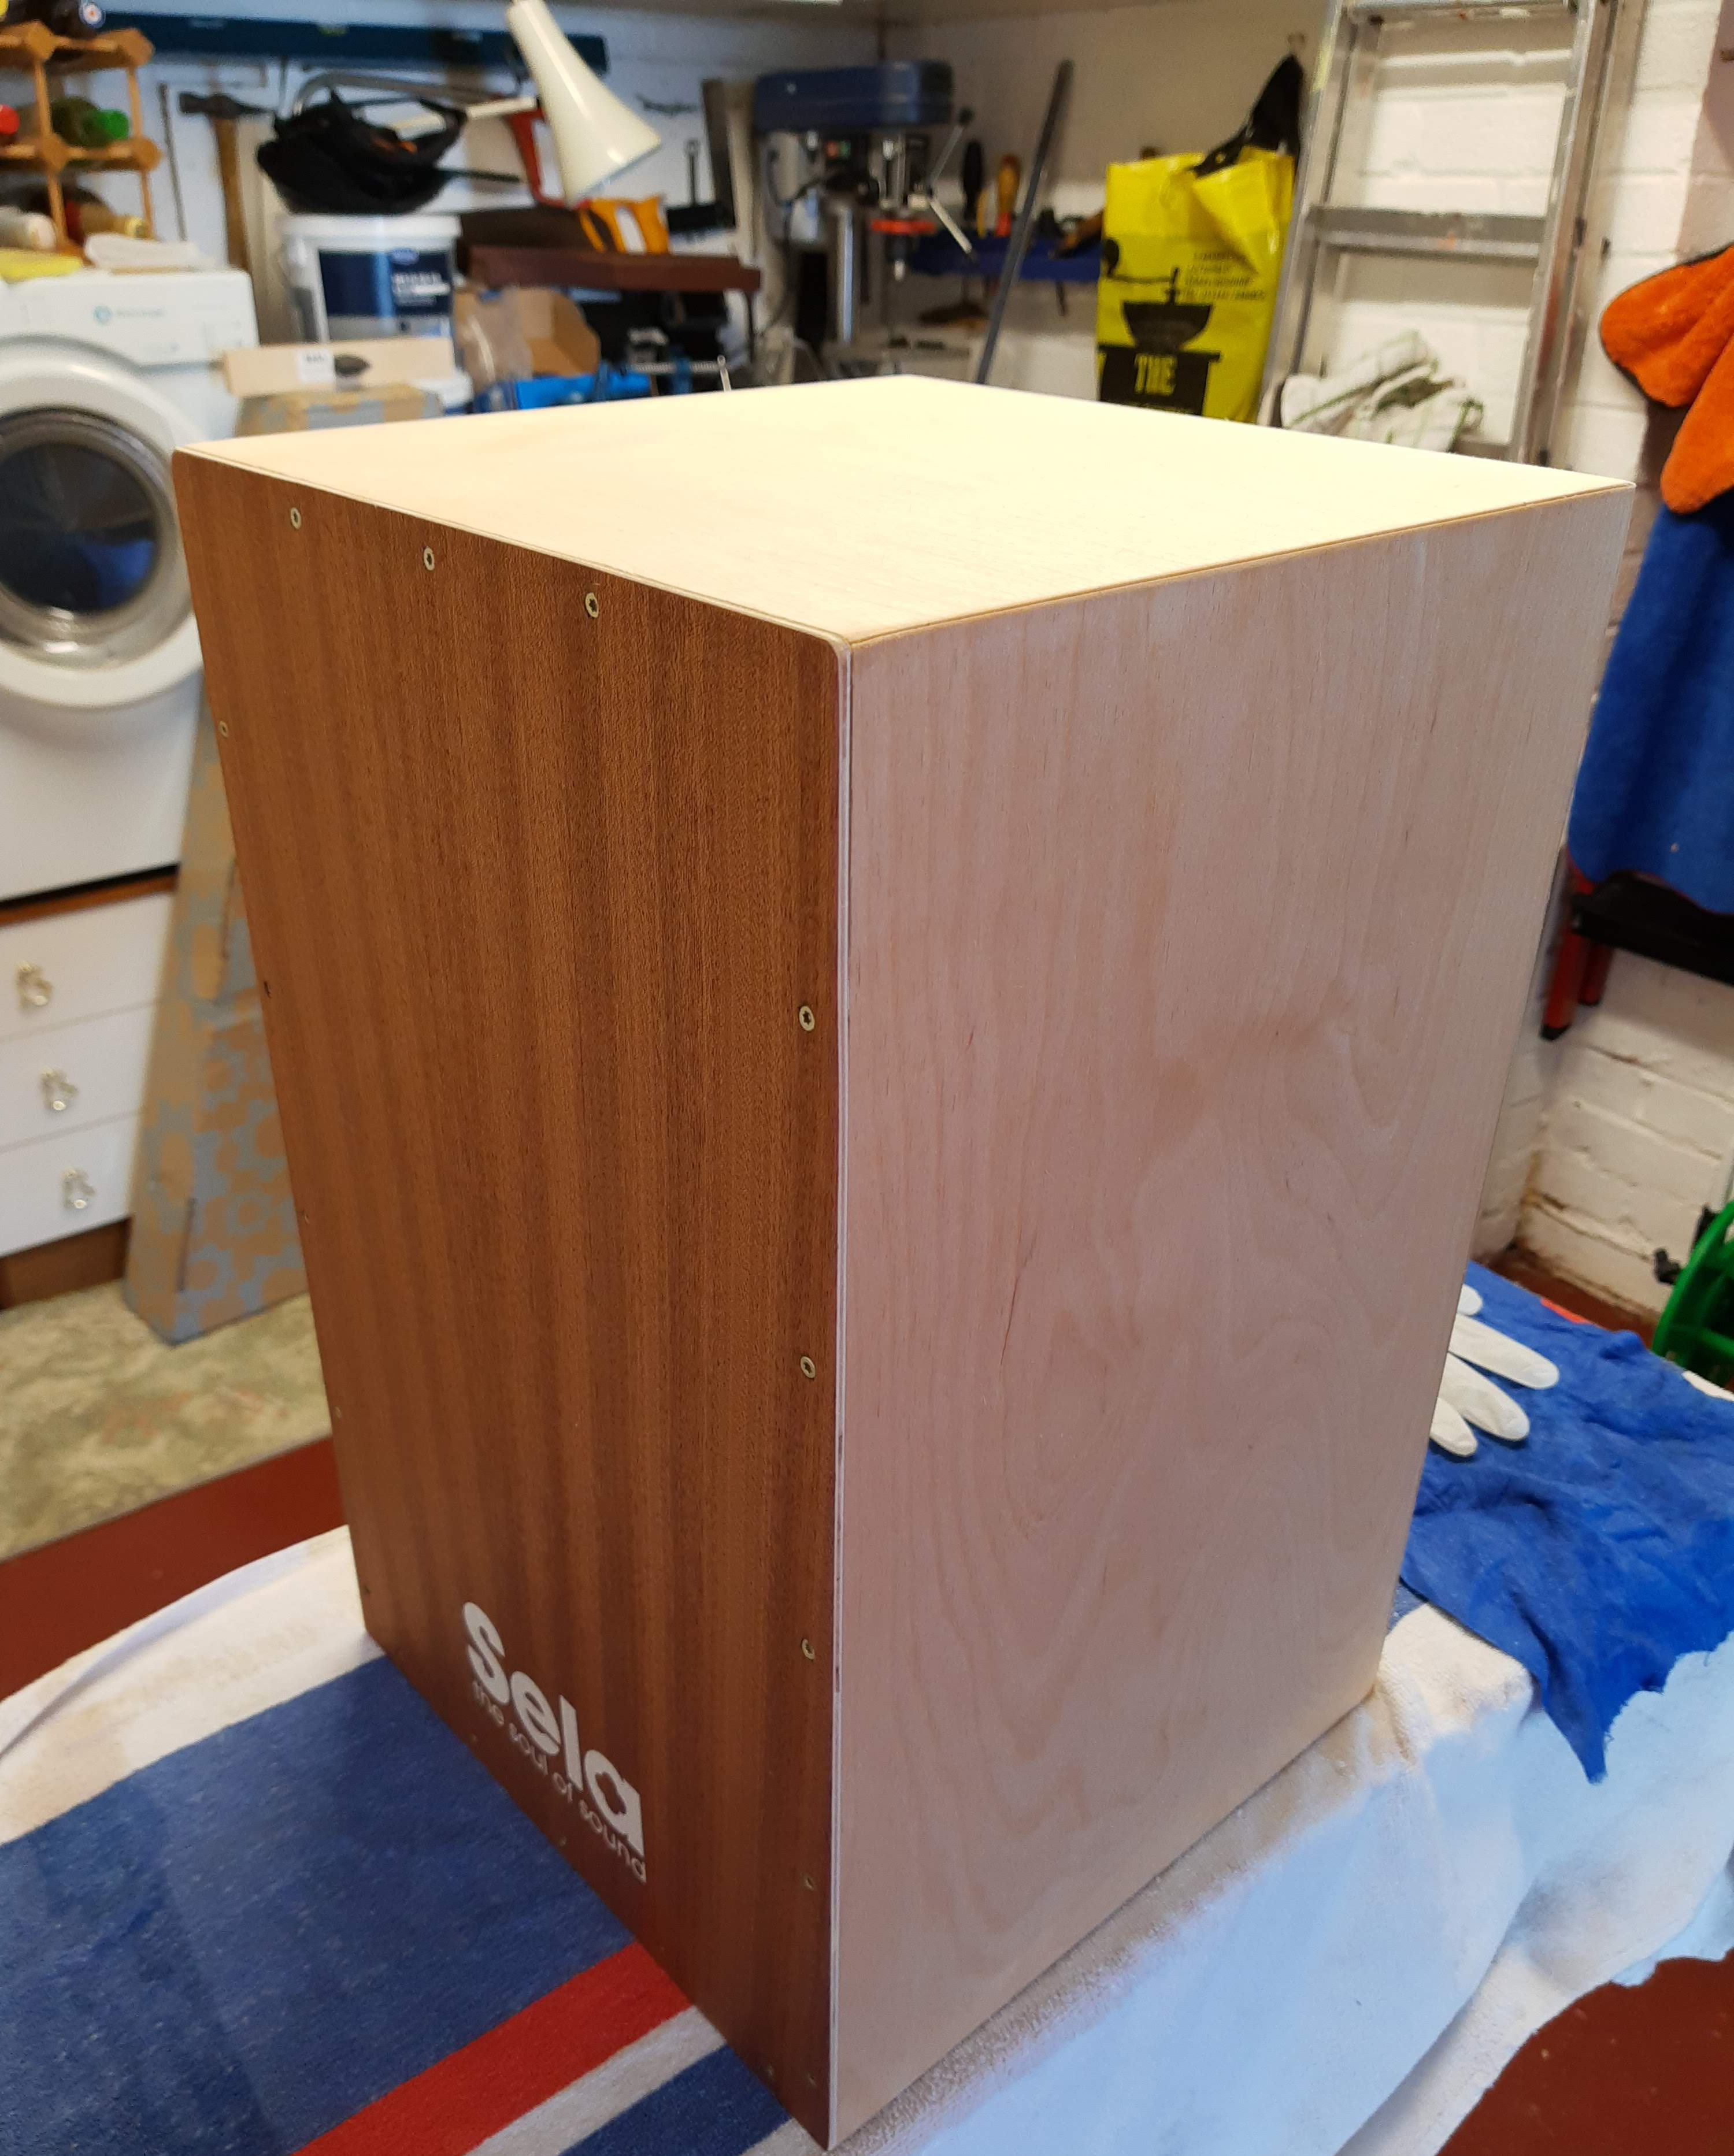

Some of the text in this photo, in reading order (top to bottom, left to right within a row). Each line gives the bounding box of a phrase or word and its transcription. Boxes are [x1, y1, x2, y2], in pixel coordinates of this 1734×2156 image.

[463, 1602, 645, 1857] Sela
[472, 1680, 646, 1884] the soul of sound
